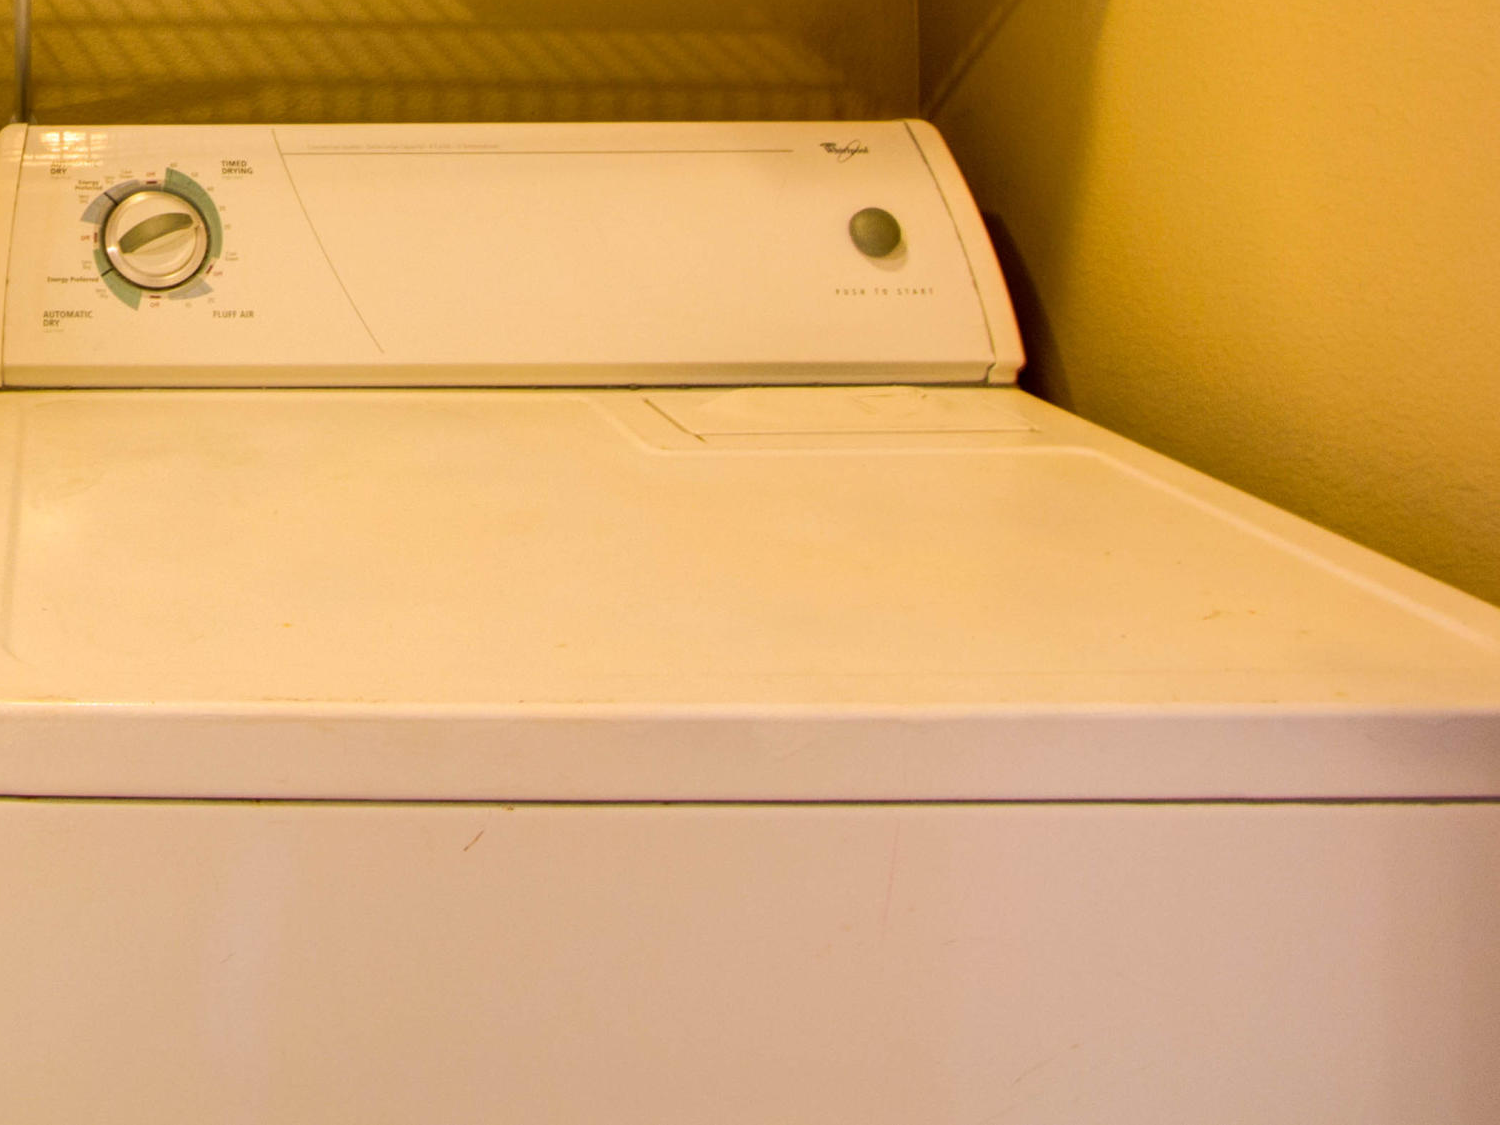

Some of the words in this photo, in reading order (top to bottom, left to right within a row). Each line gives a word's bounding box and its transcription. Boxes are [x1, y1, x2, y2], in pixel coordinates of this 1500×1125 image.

[221, 167, 253, 175] DRYING
[43, 310, 93, 319] AUTOMATIC
[212, 310, 238, 318] FLUFF
[240, 310, 254, 318] AIR
[43, 319, 60, 327] DRY
